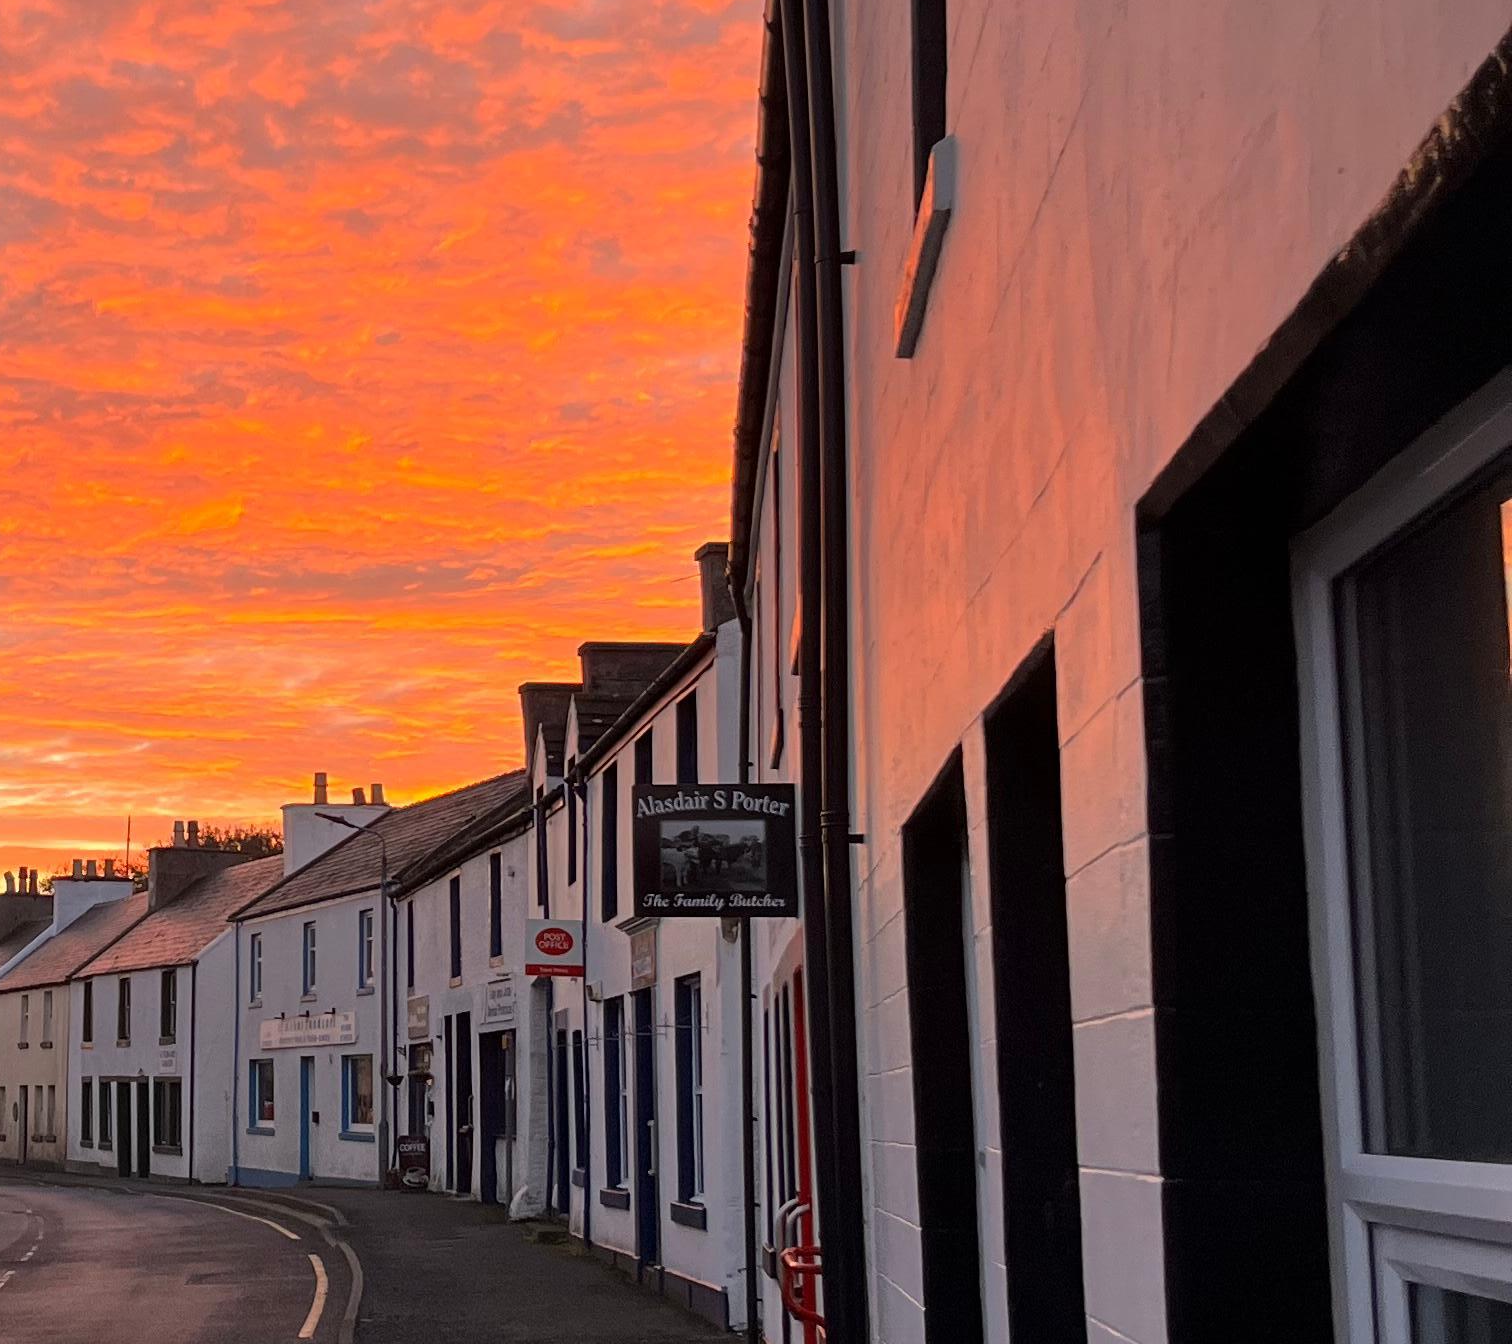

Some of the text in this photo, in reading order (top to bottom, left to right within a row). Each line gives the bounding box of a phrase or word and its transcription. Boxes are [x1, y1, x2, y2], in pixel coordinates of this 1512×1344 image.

[636, 790, 790, 818] Alasdair S Porter
[642, 893, 787, 911] The Family Butcher
[543, 933, 566, 941] POST
[539, 941, 569, 949] OFFICE
[399, 1143, 426, 1152] COFFEE
